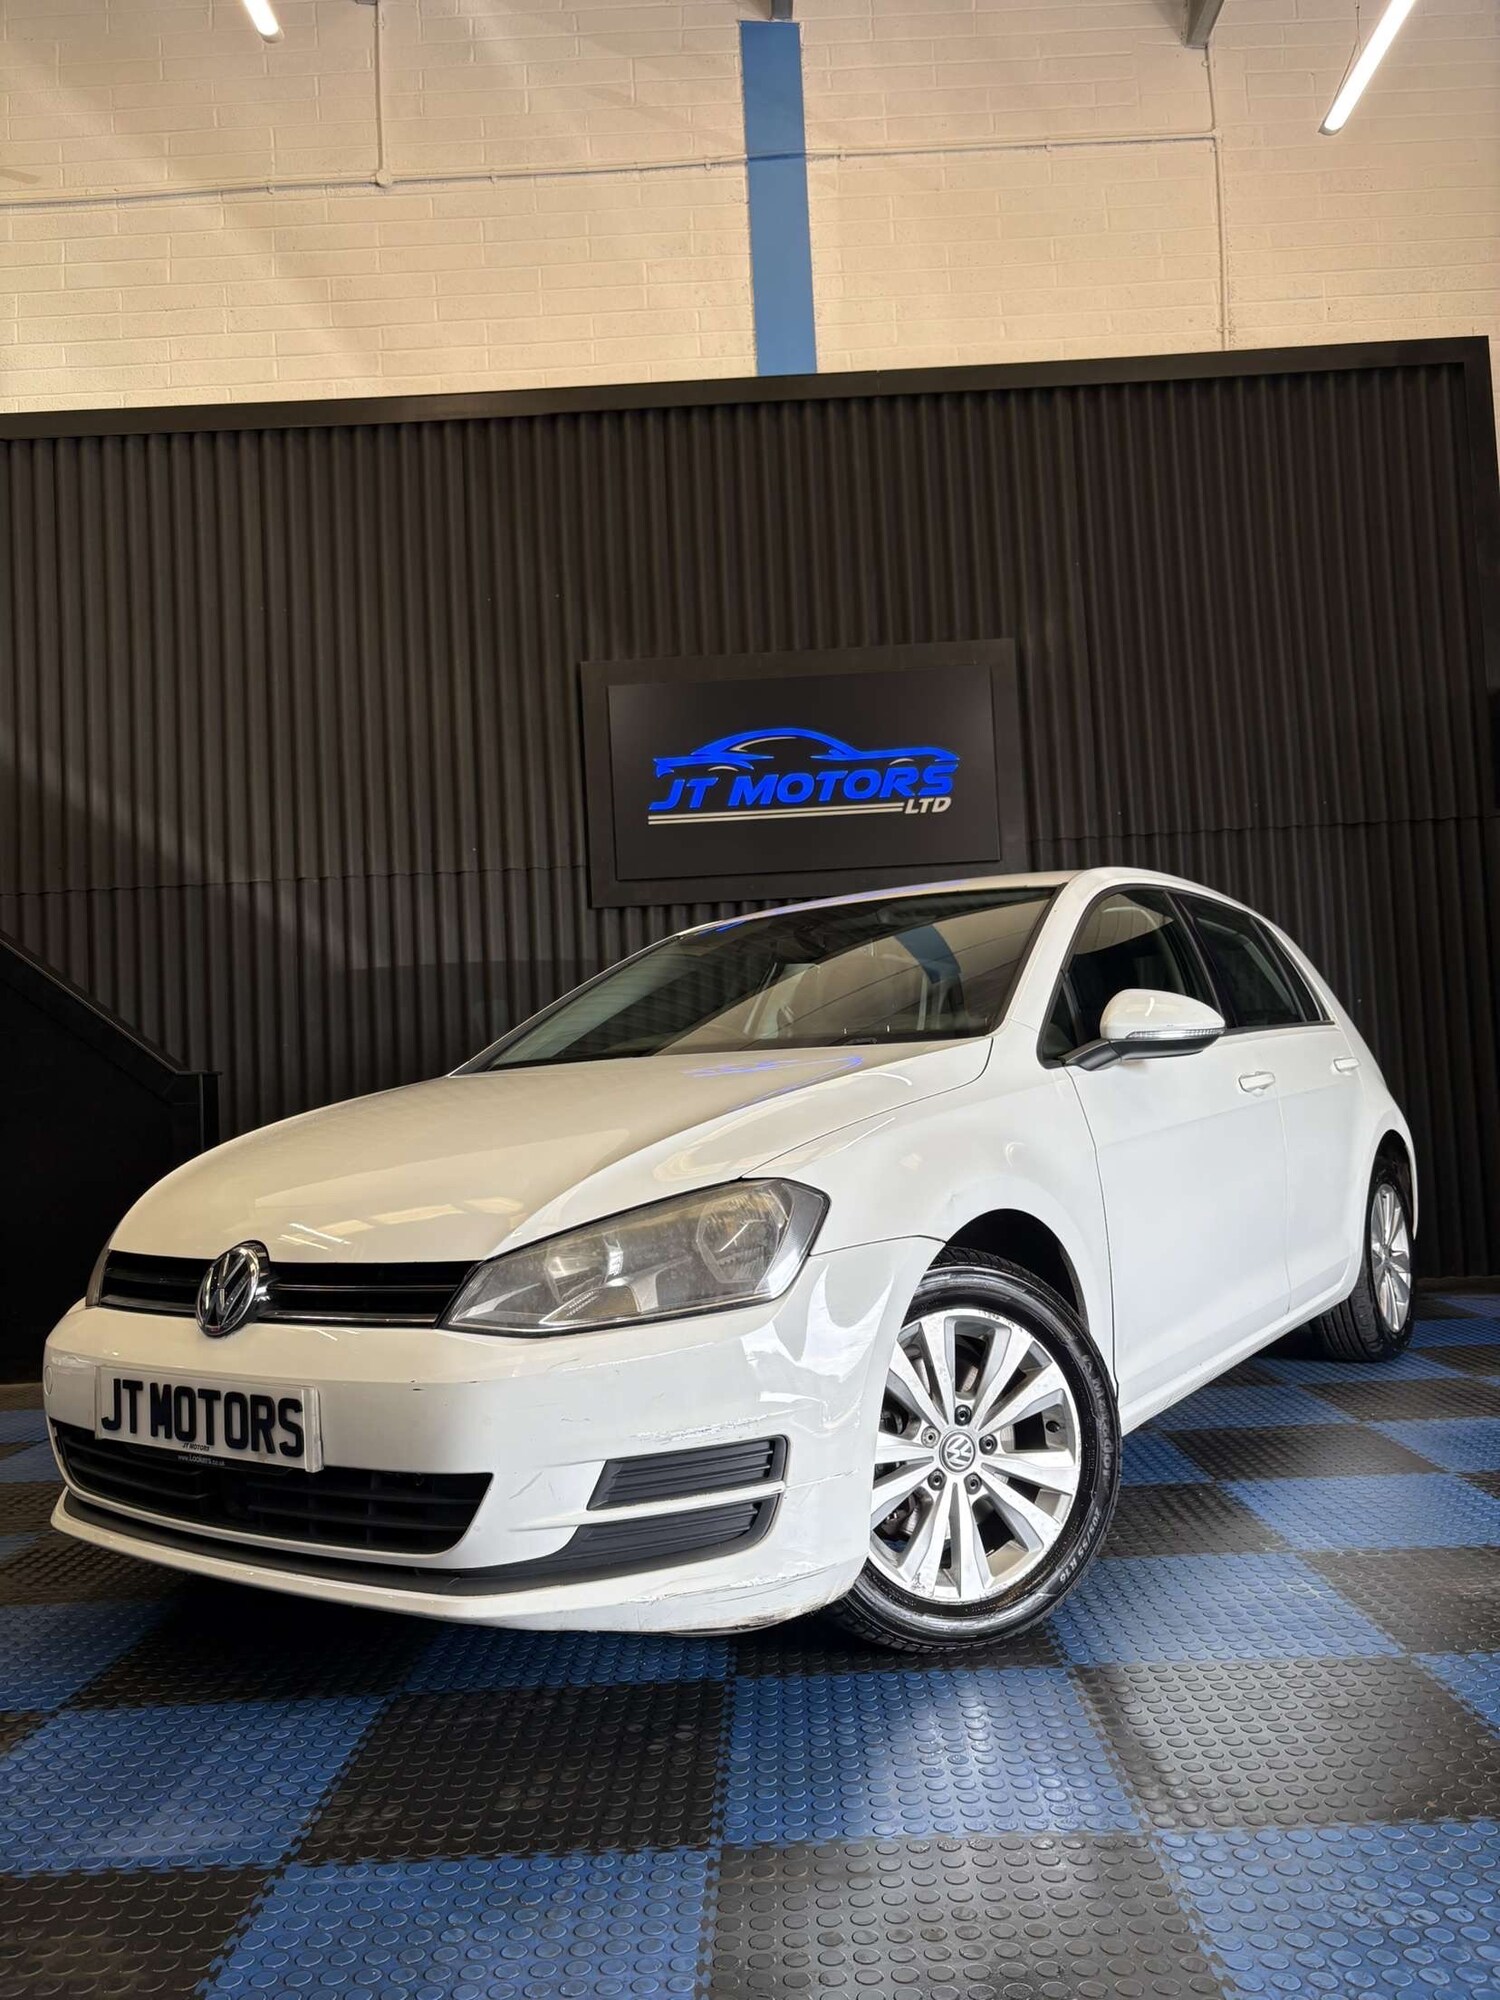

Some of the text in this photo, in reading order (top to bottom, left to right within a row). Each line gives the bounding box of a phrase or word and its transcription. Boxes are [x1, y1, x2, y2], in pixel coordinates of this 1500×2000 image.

[650, 764, 958, 811] JT MOTORS
[905, 796, 952, 815] LTD
[101, 1378, 305, 1458] JT MOTORS
[189, 1443, 210, 1451] MOTORS
